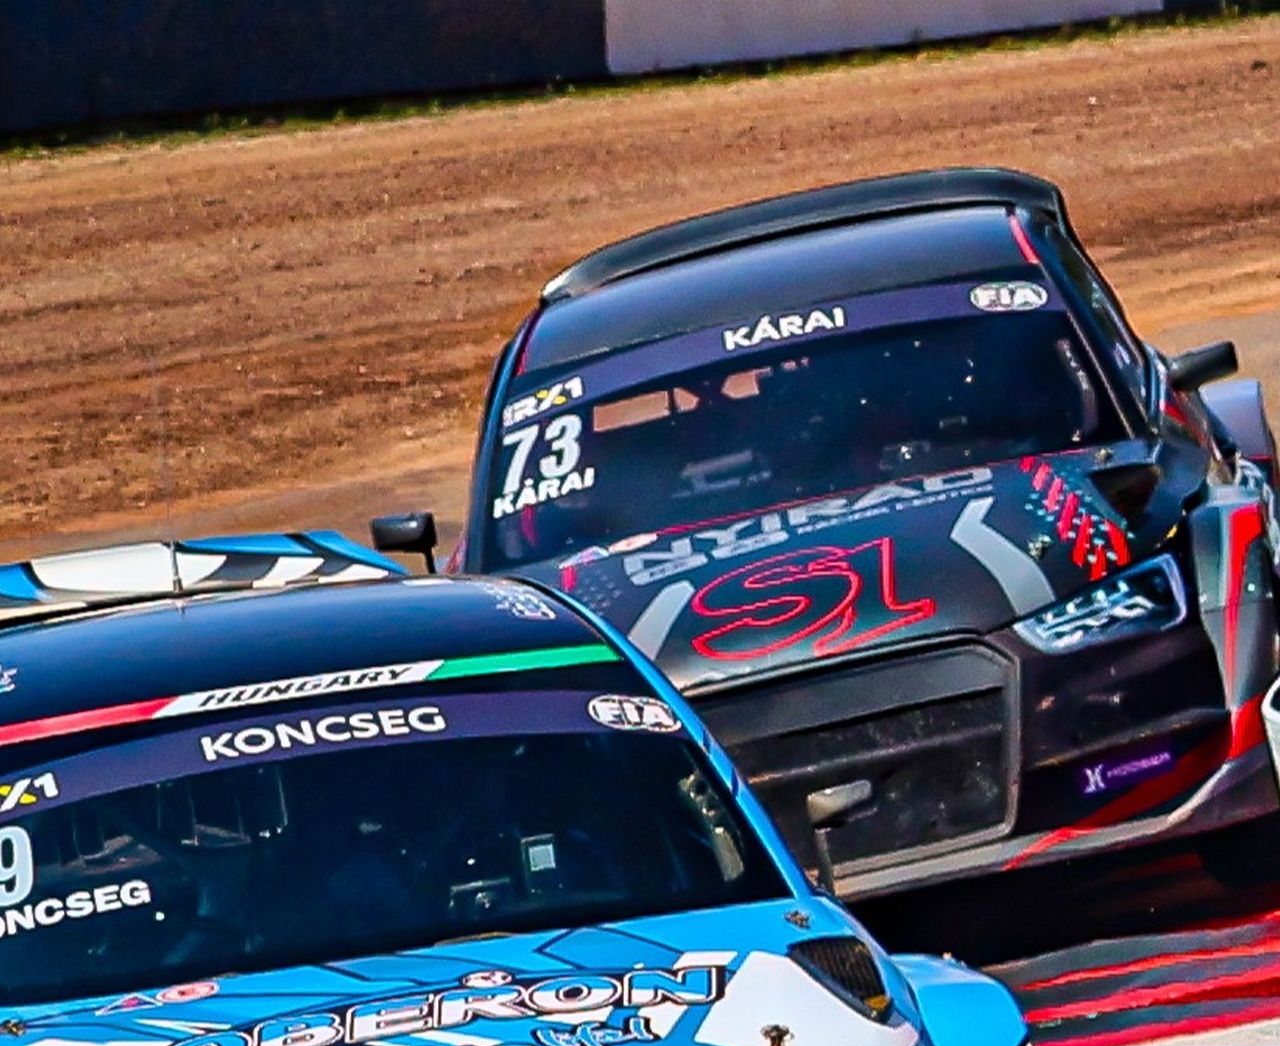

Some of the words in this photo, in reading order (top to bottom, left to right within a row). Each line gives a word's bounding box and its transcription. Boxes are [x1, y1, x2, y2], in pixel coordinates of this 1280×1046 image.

[974, 284, 1045, 309] FIA
[723, 306, 844, 351] KÁRAI
[502, 414, 582, 494] 73
[198, 667, 412, 708] HUNGARY
[200, 707, 446, 761] KONCSEG
[595, 700, 676, 730] FIA
